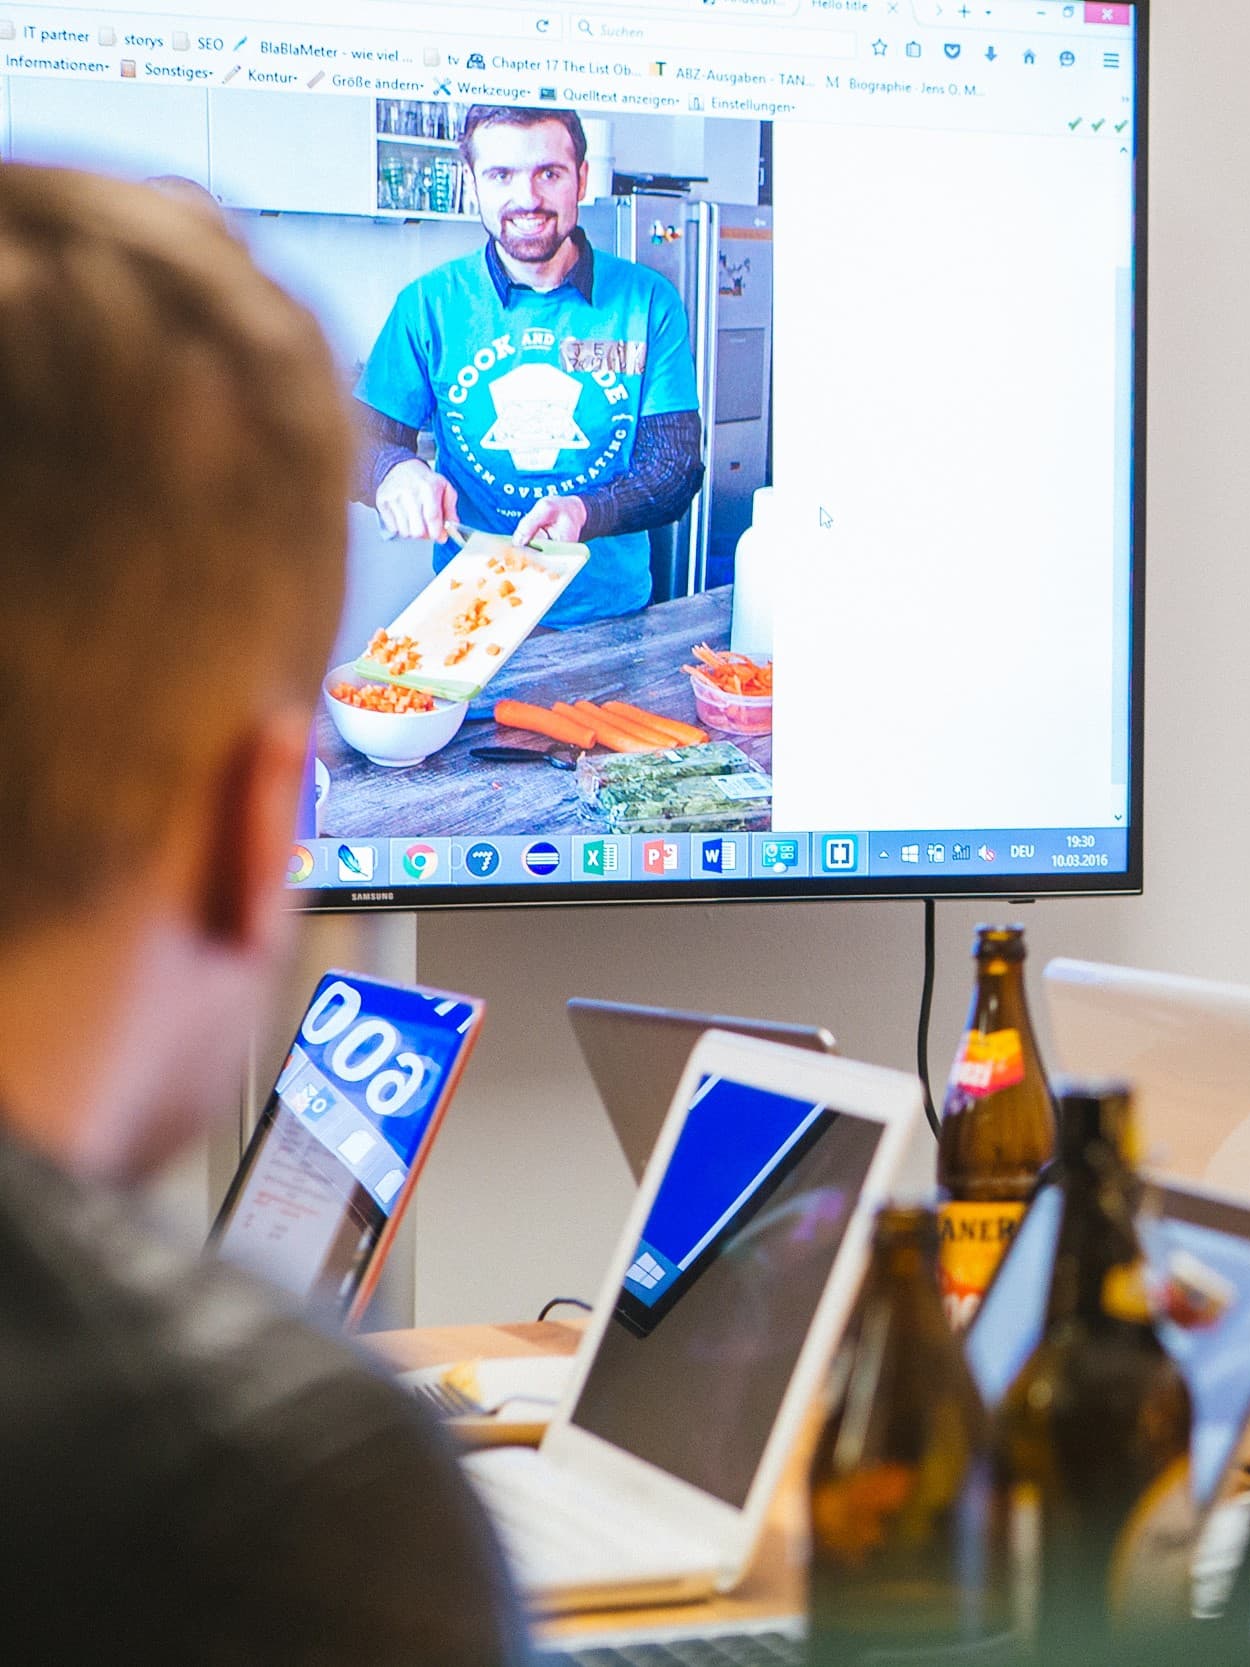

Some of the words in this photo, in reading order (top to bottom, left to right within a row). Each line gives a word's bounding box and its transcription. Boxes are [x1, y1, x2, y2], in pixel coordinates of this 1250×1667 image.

[845, 1, 869, 12] title
[23, 26, 37, 39] IT
[41, 28, 90, 44] partner
[600, 24, 644, 38] Suchen
[124, 34, 164, 50] storys
[198, 37, 224, 51] SEO
[260, 41, 338, 59] BlaBlaMeter
[352, 50, 374, 61] wie
[377, 49, 399, 62] viel
[6, 54, 103, 73] Informationen
[447, 54, 460, 66] tv
[492, 56, 541, 73] Chapter
[546, 59, 559, 72] 17
[564, 60, 585, 74] The
[589, 61, 609, 75] List
[145, 63, 208, 80] Sonstiges
[248, 70, 294, 84] Kontur
[332, 75, 371, 89] Größe
[375, 77, 420, 92] ändern
[457, 82, 527, 100] Werkzeuge
[849, 78, 912, 96] Biographie
[920, 82, 945, 95] Jens
[563, 88, 617, 104] Quelltext
[621, 93, 675, 108] anzeigen
[711, 97, 793, 115] Einstellungen
[448, 334, 516, 405] COOK
[521, 332, 555, 346] AND
[1066, 835, 1096, 848] 19:30
[704, 848, 721, 863] W
[1010, 845, 1035, 858] DEU
[1052, 854, 1108, 867] 10.03.2016
[351, 892, 394, 902] SAMSUNG
